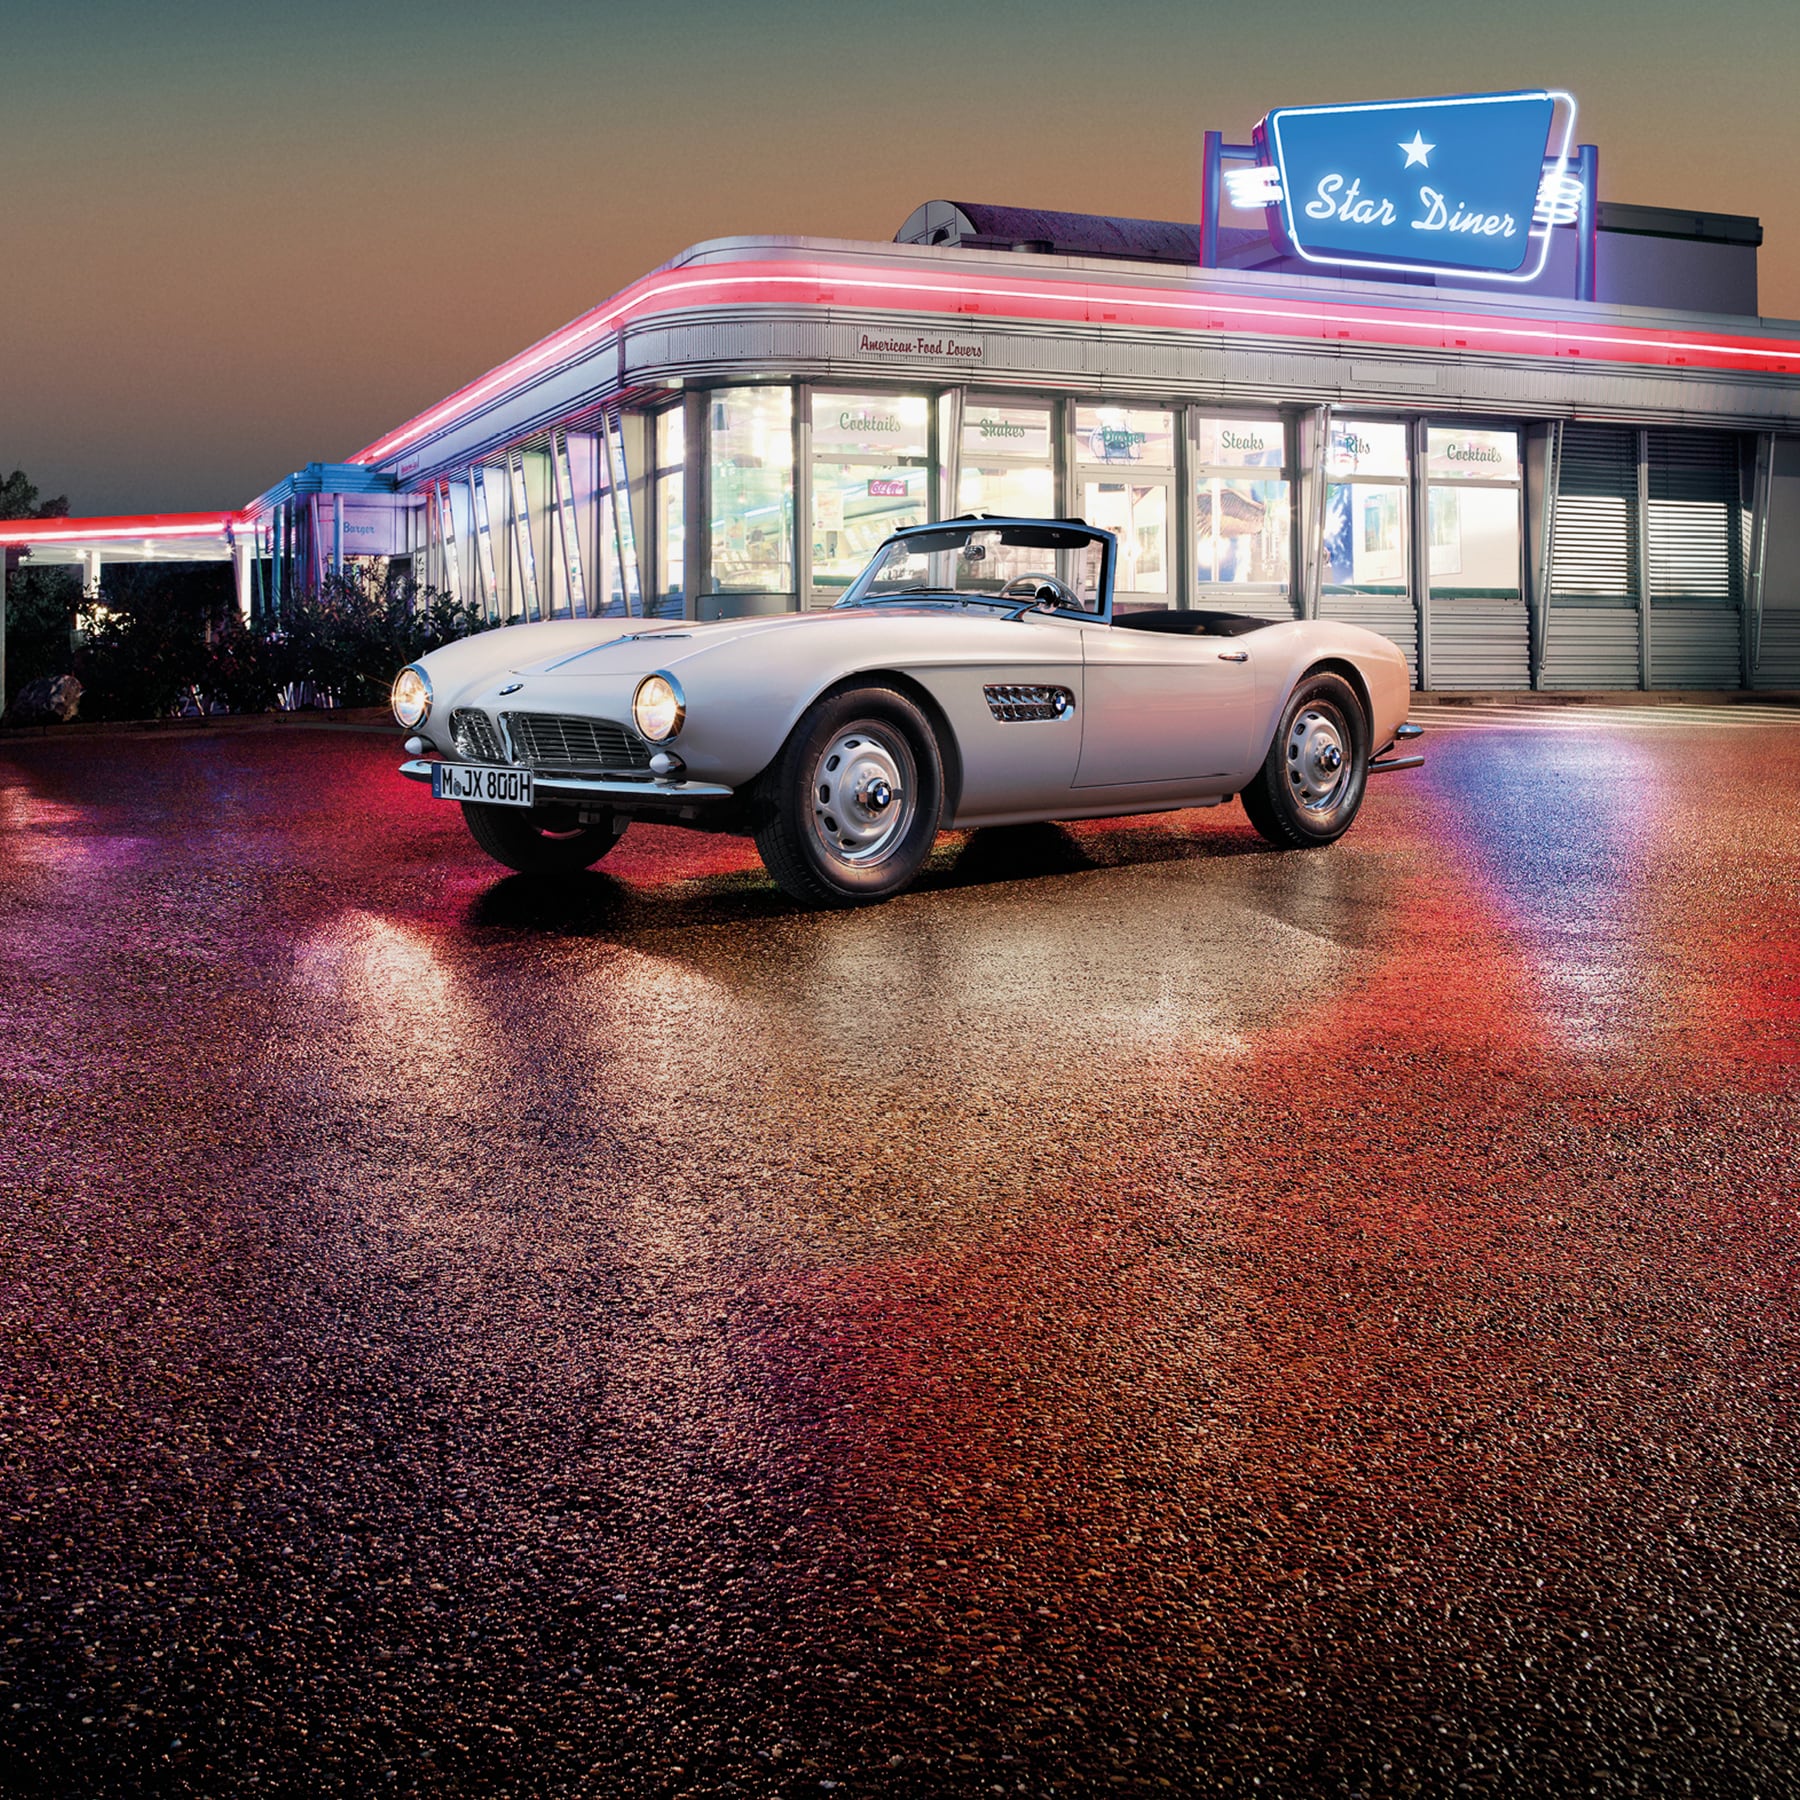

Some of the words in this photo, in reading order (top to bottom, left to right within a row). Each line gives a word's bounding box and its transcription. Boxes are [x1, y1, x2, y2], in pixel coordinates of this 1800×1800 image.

[1305, 173, 1396, 226] Star
[1411, 186, 1516, 237] Diner
[860, 335, 942, 354] American-Food
[946, 340, 982, 357] Lovers
[840, 411, 901, 432] Cocktails
[980, 418, 1025, 438] Shakes
[1222, 430, 1264, 450] Steaks
[1345, 436, 1370, 454] Ribs
[1447, 443, 1502, 462] Cocktails
[442, 768, 453, 795] M
[462, 769, 483, 798] JX
[487, 771, 531, 802] 800H
